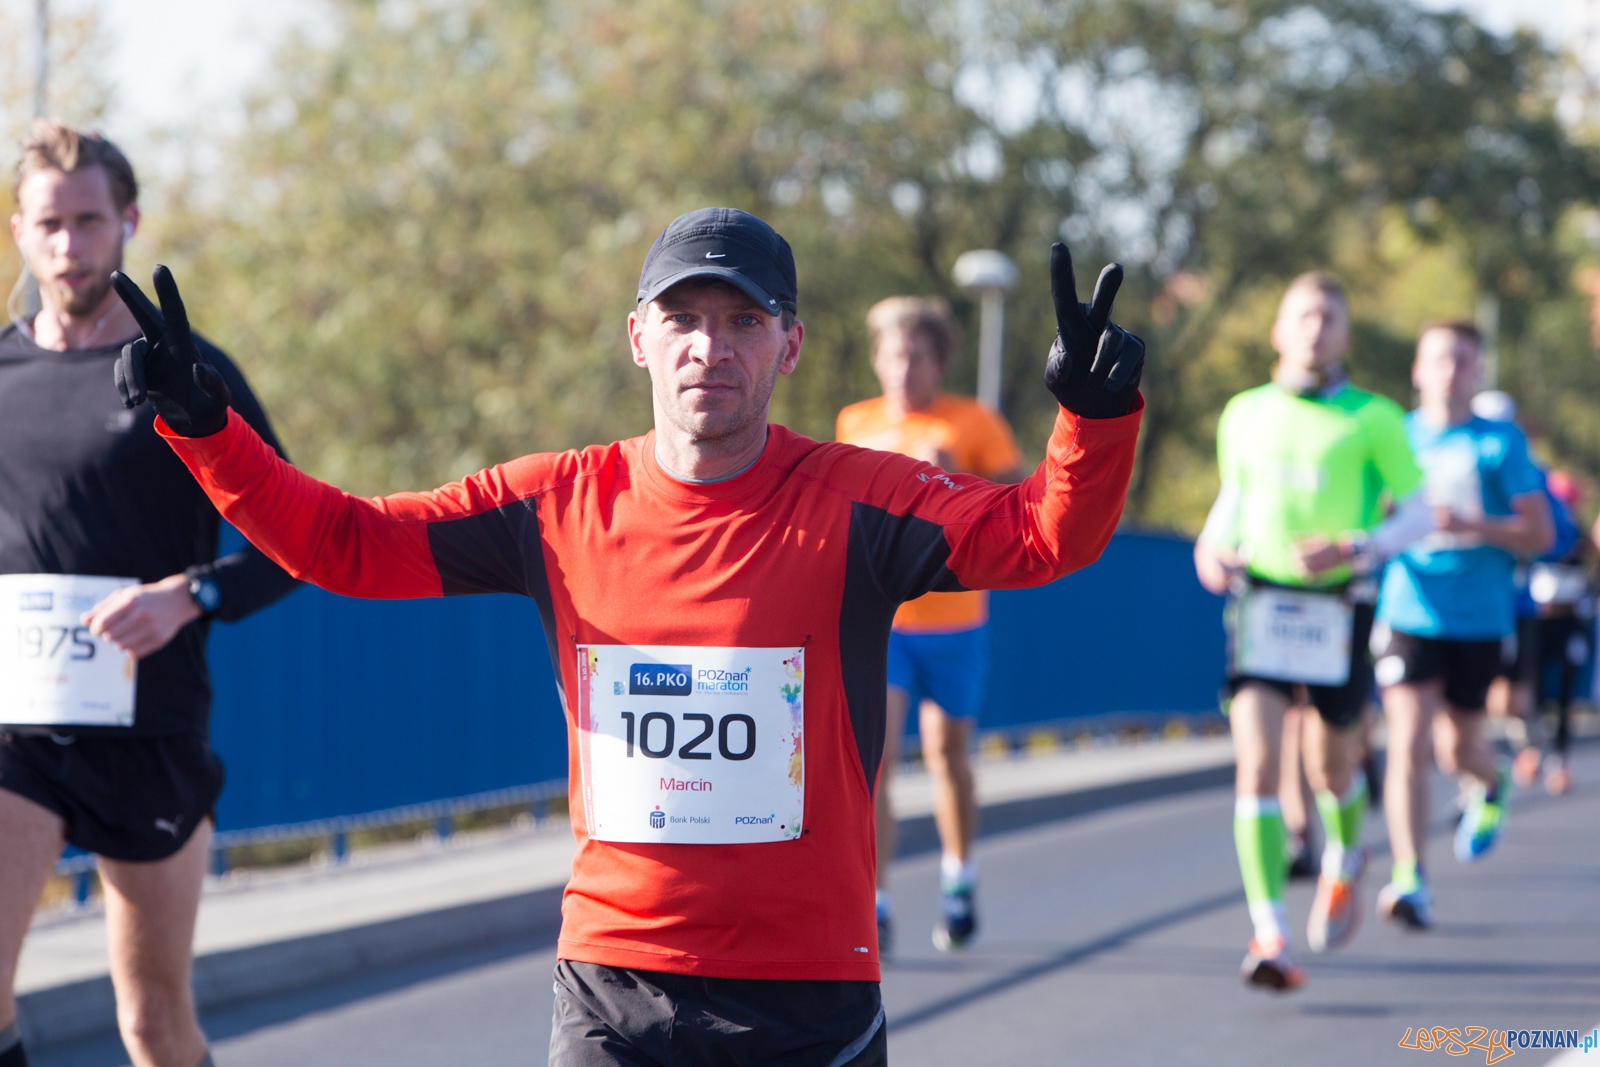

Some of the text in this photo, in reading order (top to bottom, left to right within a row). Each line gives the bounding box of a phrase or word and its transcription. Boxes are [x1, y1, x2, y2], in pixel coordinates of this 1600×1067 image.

[634, 672, 687, 687] 16. PKO
[697, 680, 748, 691] maraton
[620, 711, 757, 761] 1020
[659, 777, 713, 792] Marcin
[670, 815, 688, 824] Bank
[690, 816, 711, 825] Polski
